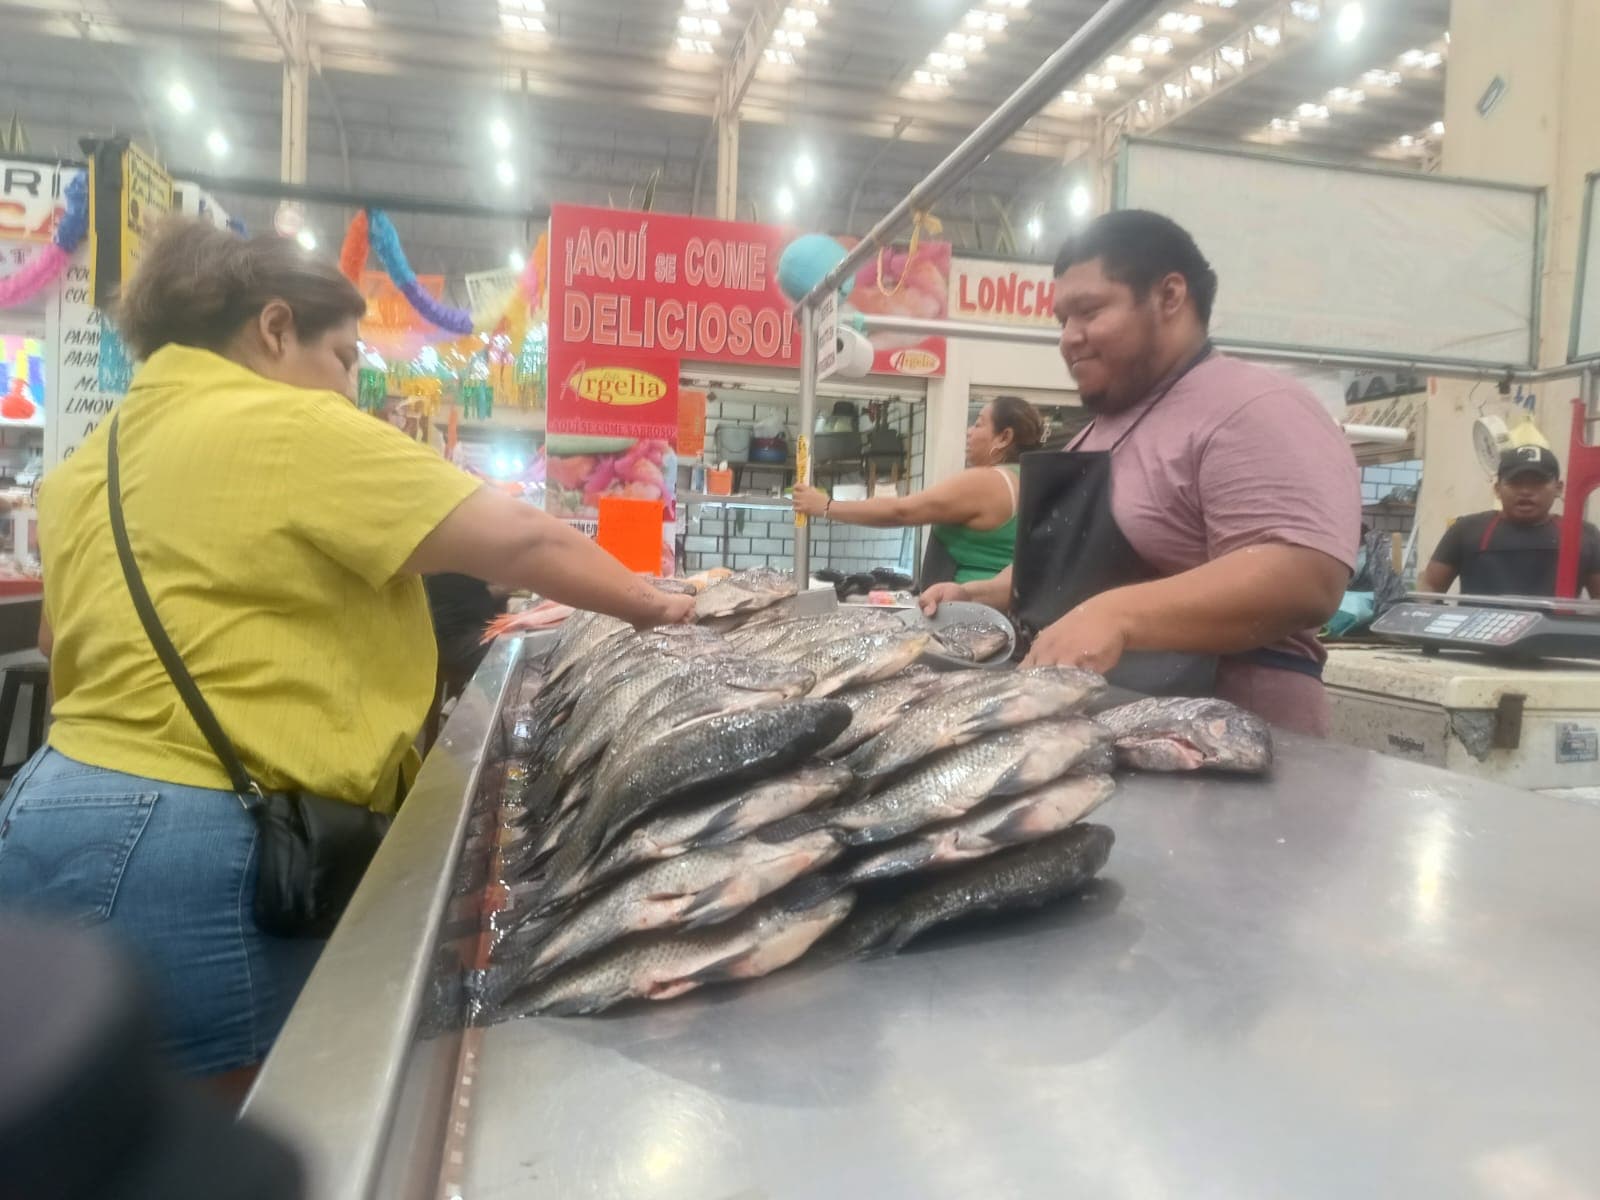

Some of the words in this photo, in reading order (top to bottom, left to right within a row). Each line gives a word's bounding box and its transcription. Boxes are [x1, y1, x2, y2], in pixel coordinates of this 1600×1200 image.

[565, 221, 648, 286] ¡AQUÍ
[654, 252, 677, 284] SE
[684, 237, 767, 291] COME
[563, 290, 793, 359] DELICIOSO!
[560, 356, 660, 404] Argelia
